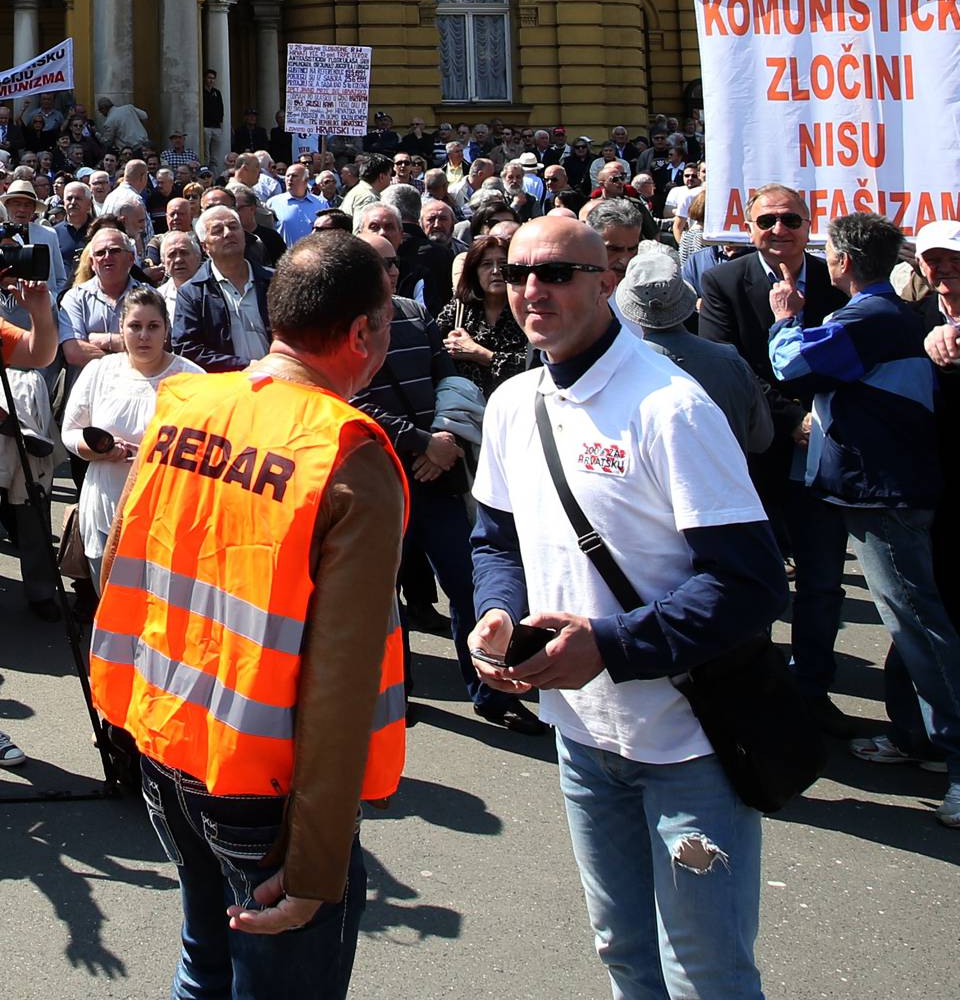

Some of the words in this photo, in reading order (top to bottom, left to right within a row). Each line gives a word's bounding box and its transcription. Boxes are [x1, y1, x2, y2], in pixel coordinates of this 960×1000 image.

[766, 43, 915, 101] ZLOČINI
[316, 126, 349, 134] HRVATSKI
[798, 121, 886, 168] NISU
[146, 425, 295, 502] REDAR
